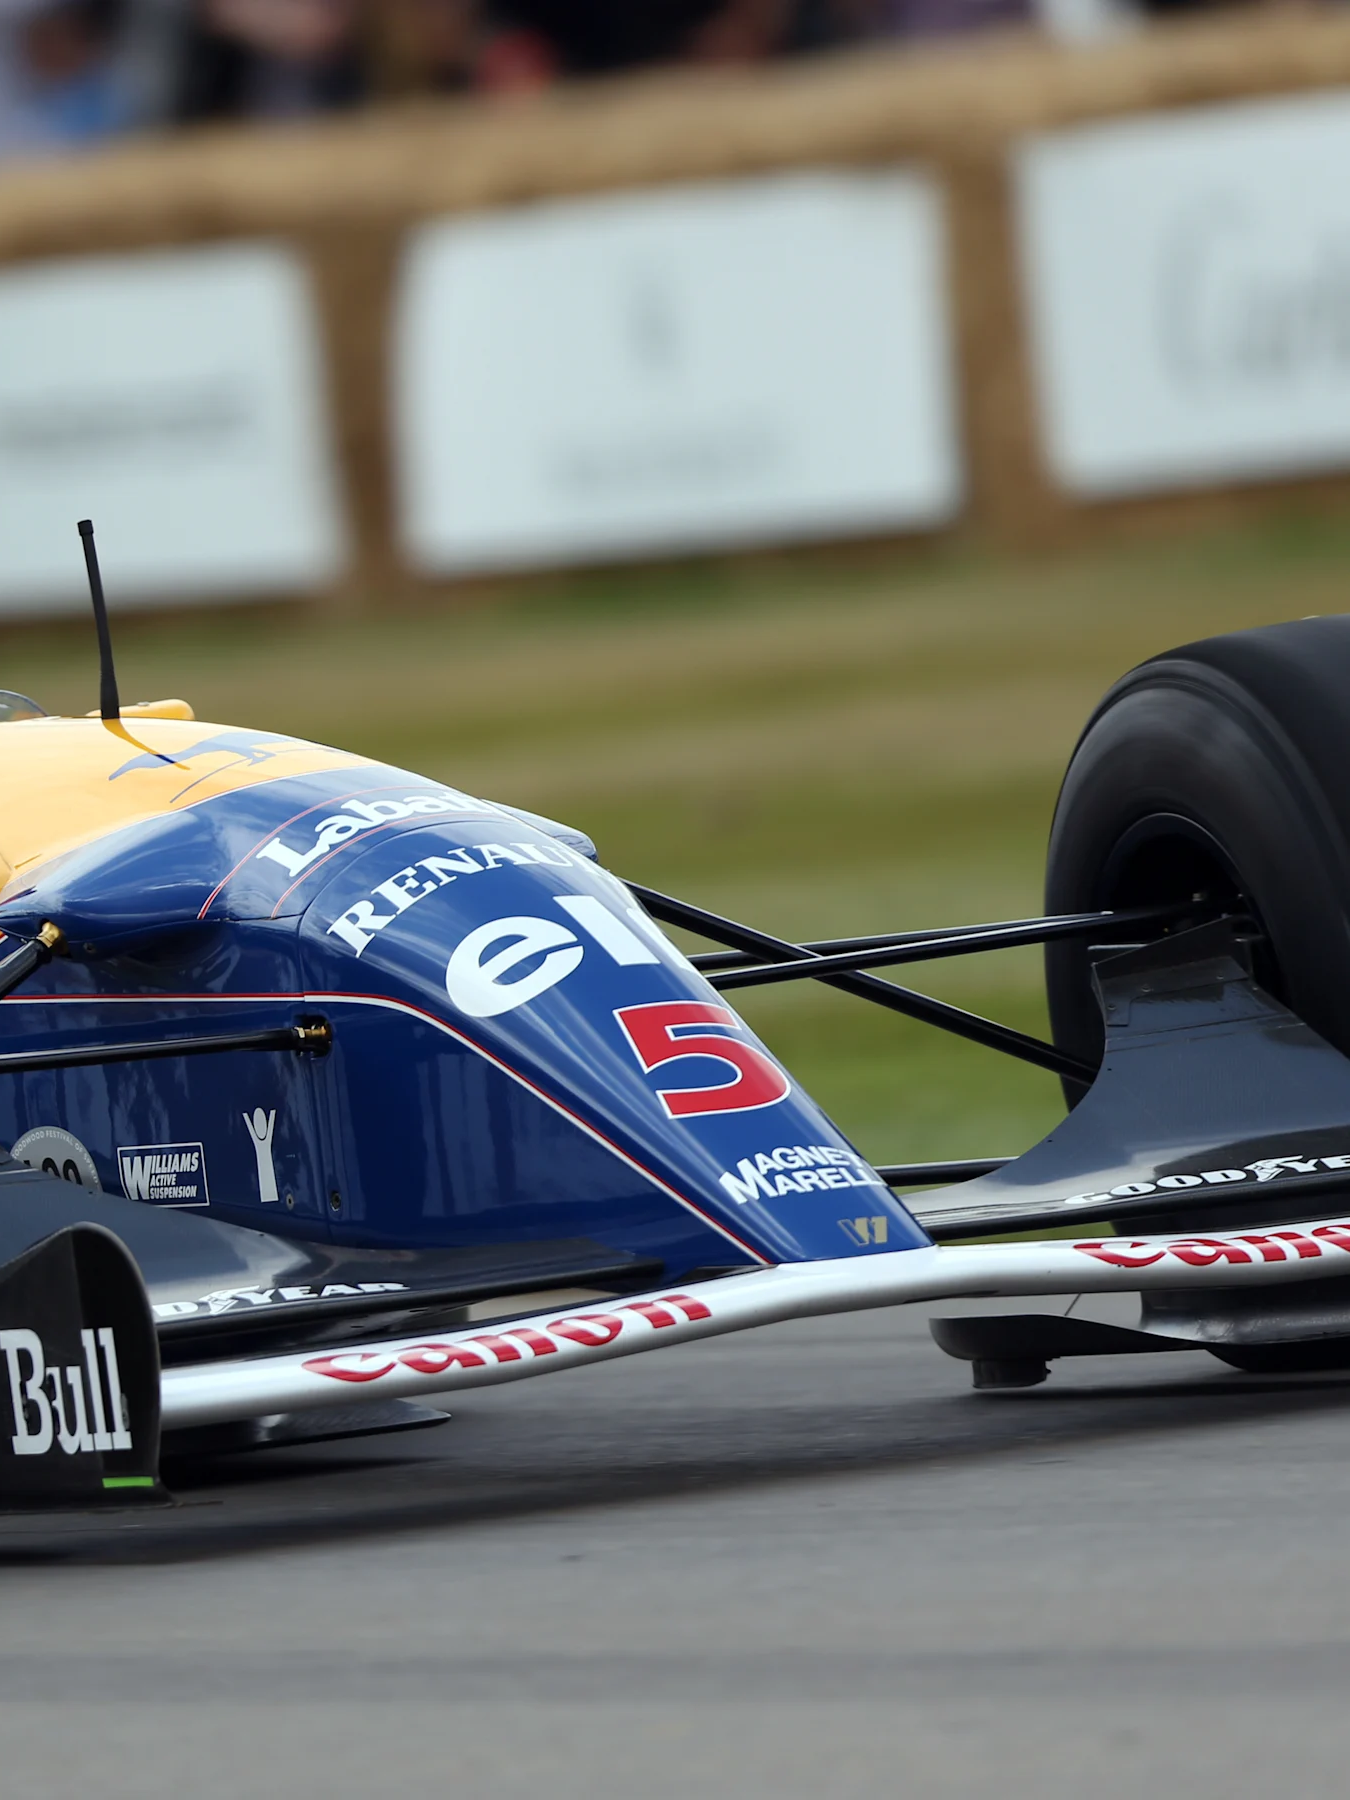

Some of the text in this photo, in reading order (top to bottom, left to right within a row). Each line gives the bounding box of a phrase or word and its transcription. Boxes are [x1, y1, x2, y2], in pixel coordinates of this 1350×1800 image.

[326, 841, 582, 959] RENAU
[445, 894, 706, 1018] el
[612, 1000, 792, 1120] 5
[45, 1129, 74, 1147] FESTIVAL
[122, 1151, 200, 1200] WILLIAMS
[149, 1185, 198, 1200] SUSPENSION
[150, 1173, 178, 1187] ACTIVE
[301, 1293, 713, 1382] Canon
